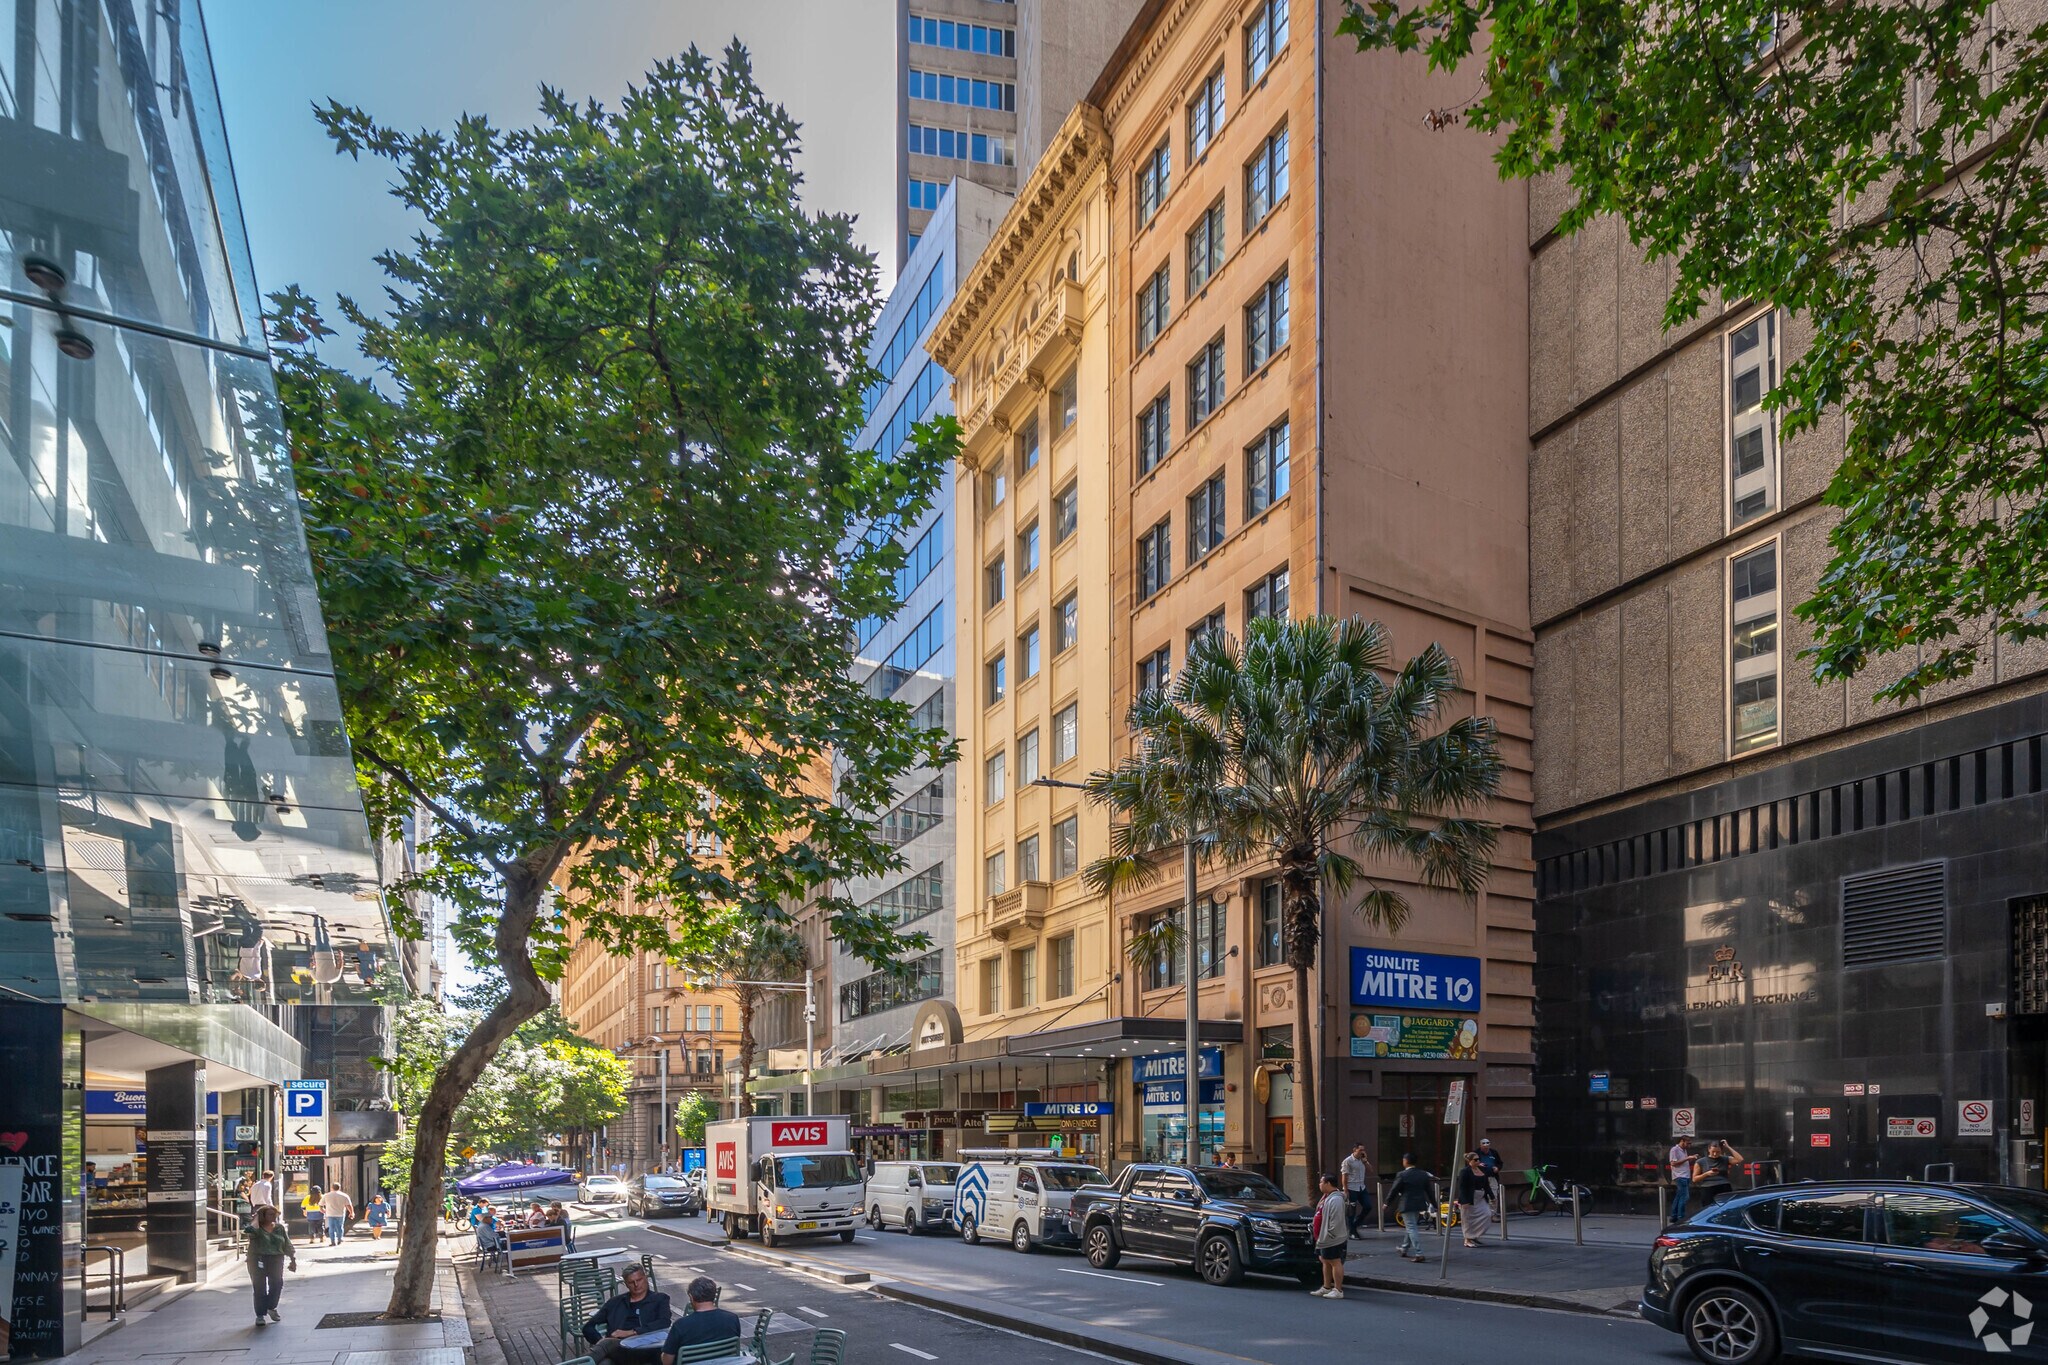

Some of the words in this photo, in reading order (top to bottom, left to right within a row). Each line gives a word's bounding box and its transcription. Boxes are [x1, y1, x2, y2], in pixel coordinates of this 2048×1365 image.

[1366, 954, 1420, 972] SUNLITE
[1360, 970, 1437, 1000] MITRE
[1445, 976, 1474, 1003] 10
[1752, 991, 1817, 1006] EXCHANGE
[1411, 1017, 1454, 1027] JAGGARD'S
[1145, 1057, 1185, 1077] MITRE
[113, 1091, 146, 1103] Buon
[1146, 1092, 1170, 1102] MITRE
[1171, 1091, 1181, 1101] 10
[1282, 1088, 1293, 1100] 74
[295, 1093, 315, 1113] P
[1044, 1104, 1081, 1115] MITRE
[1083, 1103, 1098, 1114] 10
[964, 1119, 982, 1127] Alte
[1061, 1119, 1097, 1128] ONVENIENCE
[778, 1127, 821, 1141] AVIS
[718, 1151, 734, 1170] AVIS
